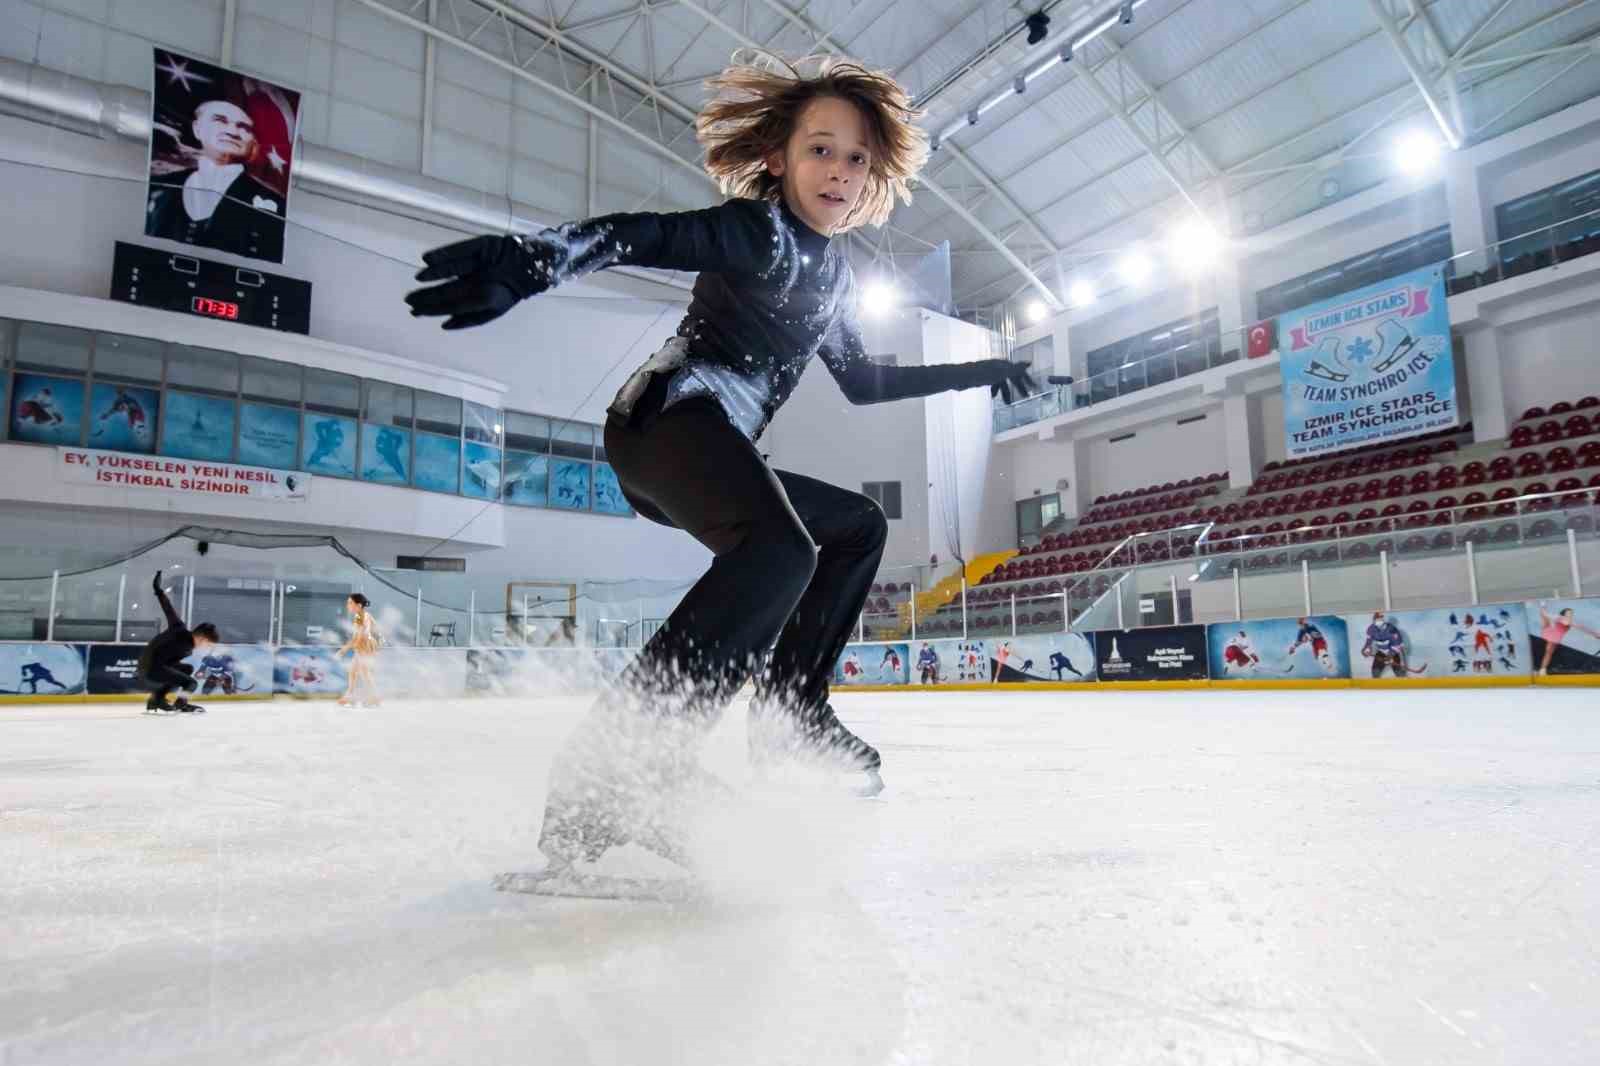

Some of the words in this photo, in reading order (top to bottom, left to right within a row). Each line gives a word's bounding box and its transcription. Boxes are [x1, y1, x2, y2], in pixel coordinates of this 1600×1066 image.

[198, 299, 237, 317] 17:33
[1344, 305, 1363, 322] ICE
[1366, 292, 1407, 316] STARS
[1304, 385, 1337, 402] TEAM
[1350, 405, 1376, 420] ICE
[1381, 392, 1436, 412] STARS
[1292, 426, 1334, 444] TEAM
[1337, 400, 1452, 434] SYNCHRO-ICE
[64, 453, 89, 467] EY,
[96, 454, 187, 474] YÜKSELEN
[192, 466, 229, 479] YENİ
[234, 470, 279, 484] NESİL
[96, 469, 174, 488] İSTİKBAL
[180, 478, 249, 494] SİZİNDİR
